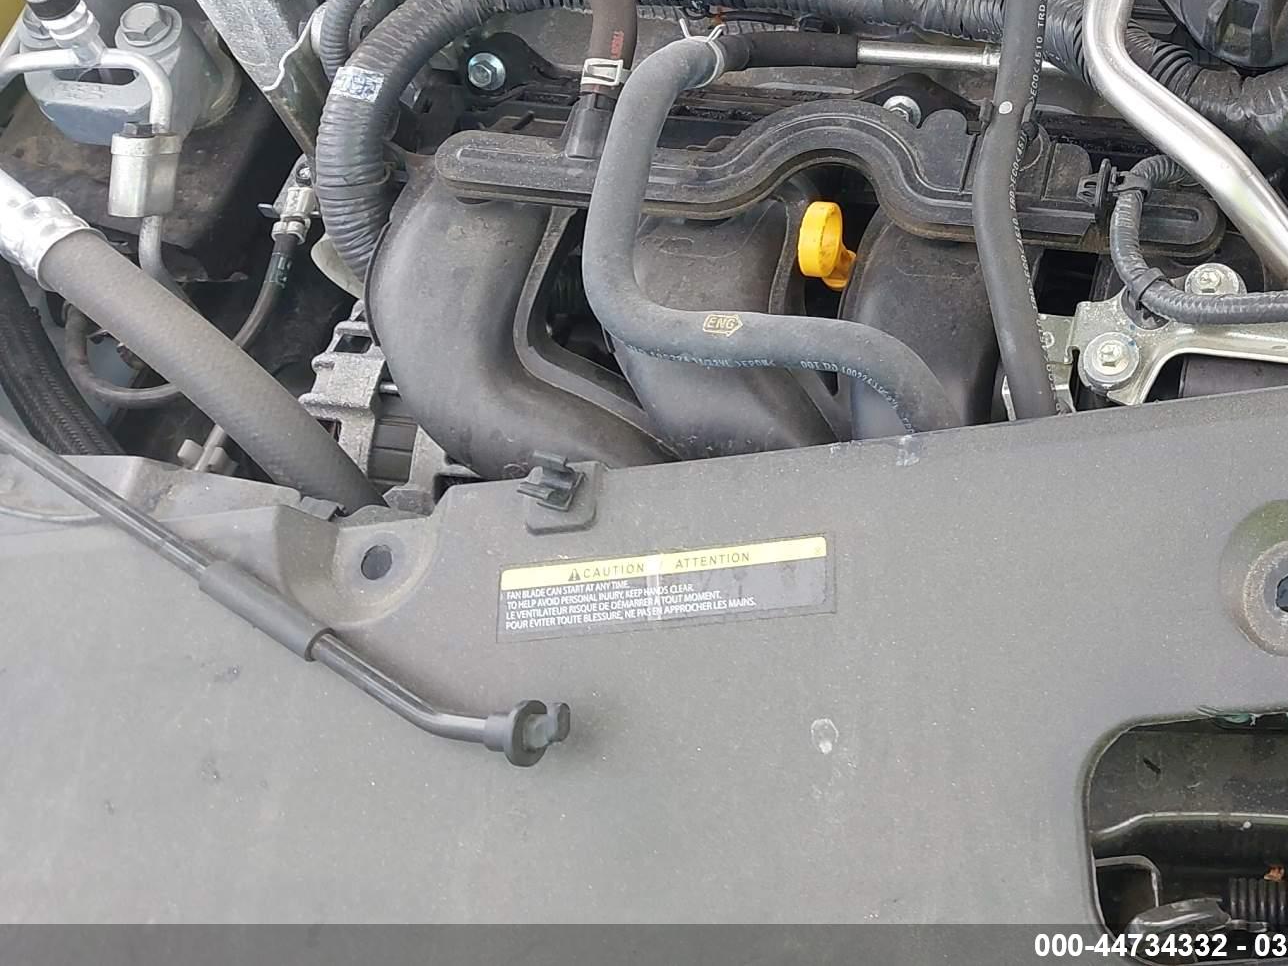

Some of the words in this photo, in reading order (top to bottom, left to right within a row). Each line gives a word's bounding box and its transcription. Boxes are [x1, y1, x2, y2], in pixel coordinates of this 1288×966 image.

[707, 317, 735, 330] ENG
[583, 562, 645, 580] CAUTION
[675, 551, 750, 570] ATTENTION
[507, 591, 521, 600] FAN
[522, 588, 546, 599] BLADE
[546, 587, 560, 596] CAN
[561, 584, 585, 595] START
[585, 583, 595, 592] AT
[595, 581, 611, 591] ANY
[507, 601, 517, 610] TO
[518, 599, 536, 609] HELP
[537, 597, 560, 607] AVOID
[561, 594, 597, 605] PERSONAL
[625, 588, 642, 598] KEEP
[644, 585, 668, 596] HANDS
[669, 583, 694, 593] CLEAR.
[506, 612, 516, 620] LE
[516, 607, 567, 619] VENTILATEUR
[569, 604, 597, 614] RISQUE
[598, 602, 610, 611] DE
[661, 594, 683, 604] TOUT
[684, 590, 722, 601] MOMENT.
[506, 620, 528, 630] POUR
[557, 614, 582, 625] TOUTE
[624, 609, 636, 619] NE
[637, 608, 651, 617] PAS
[652, 606, 662, 615] EN
[664, 602, 712, 614] APPROCHER
[713, 600, 727, 610] LES
[729, 597, 756, 608] MAINS.
